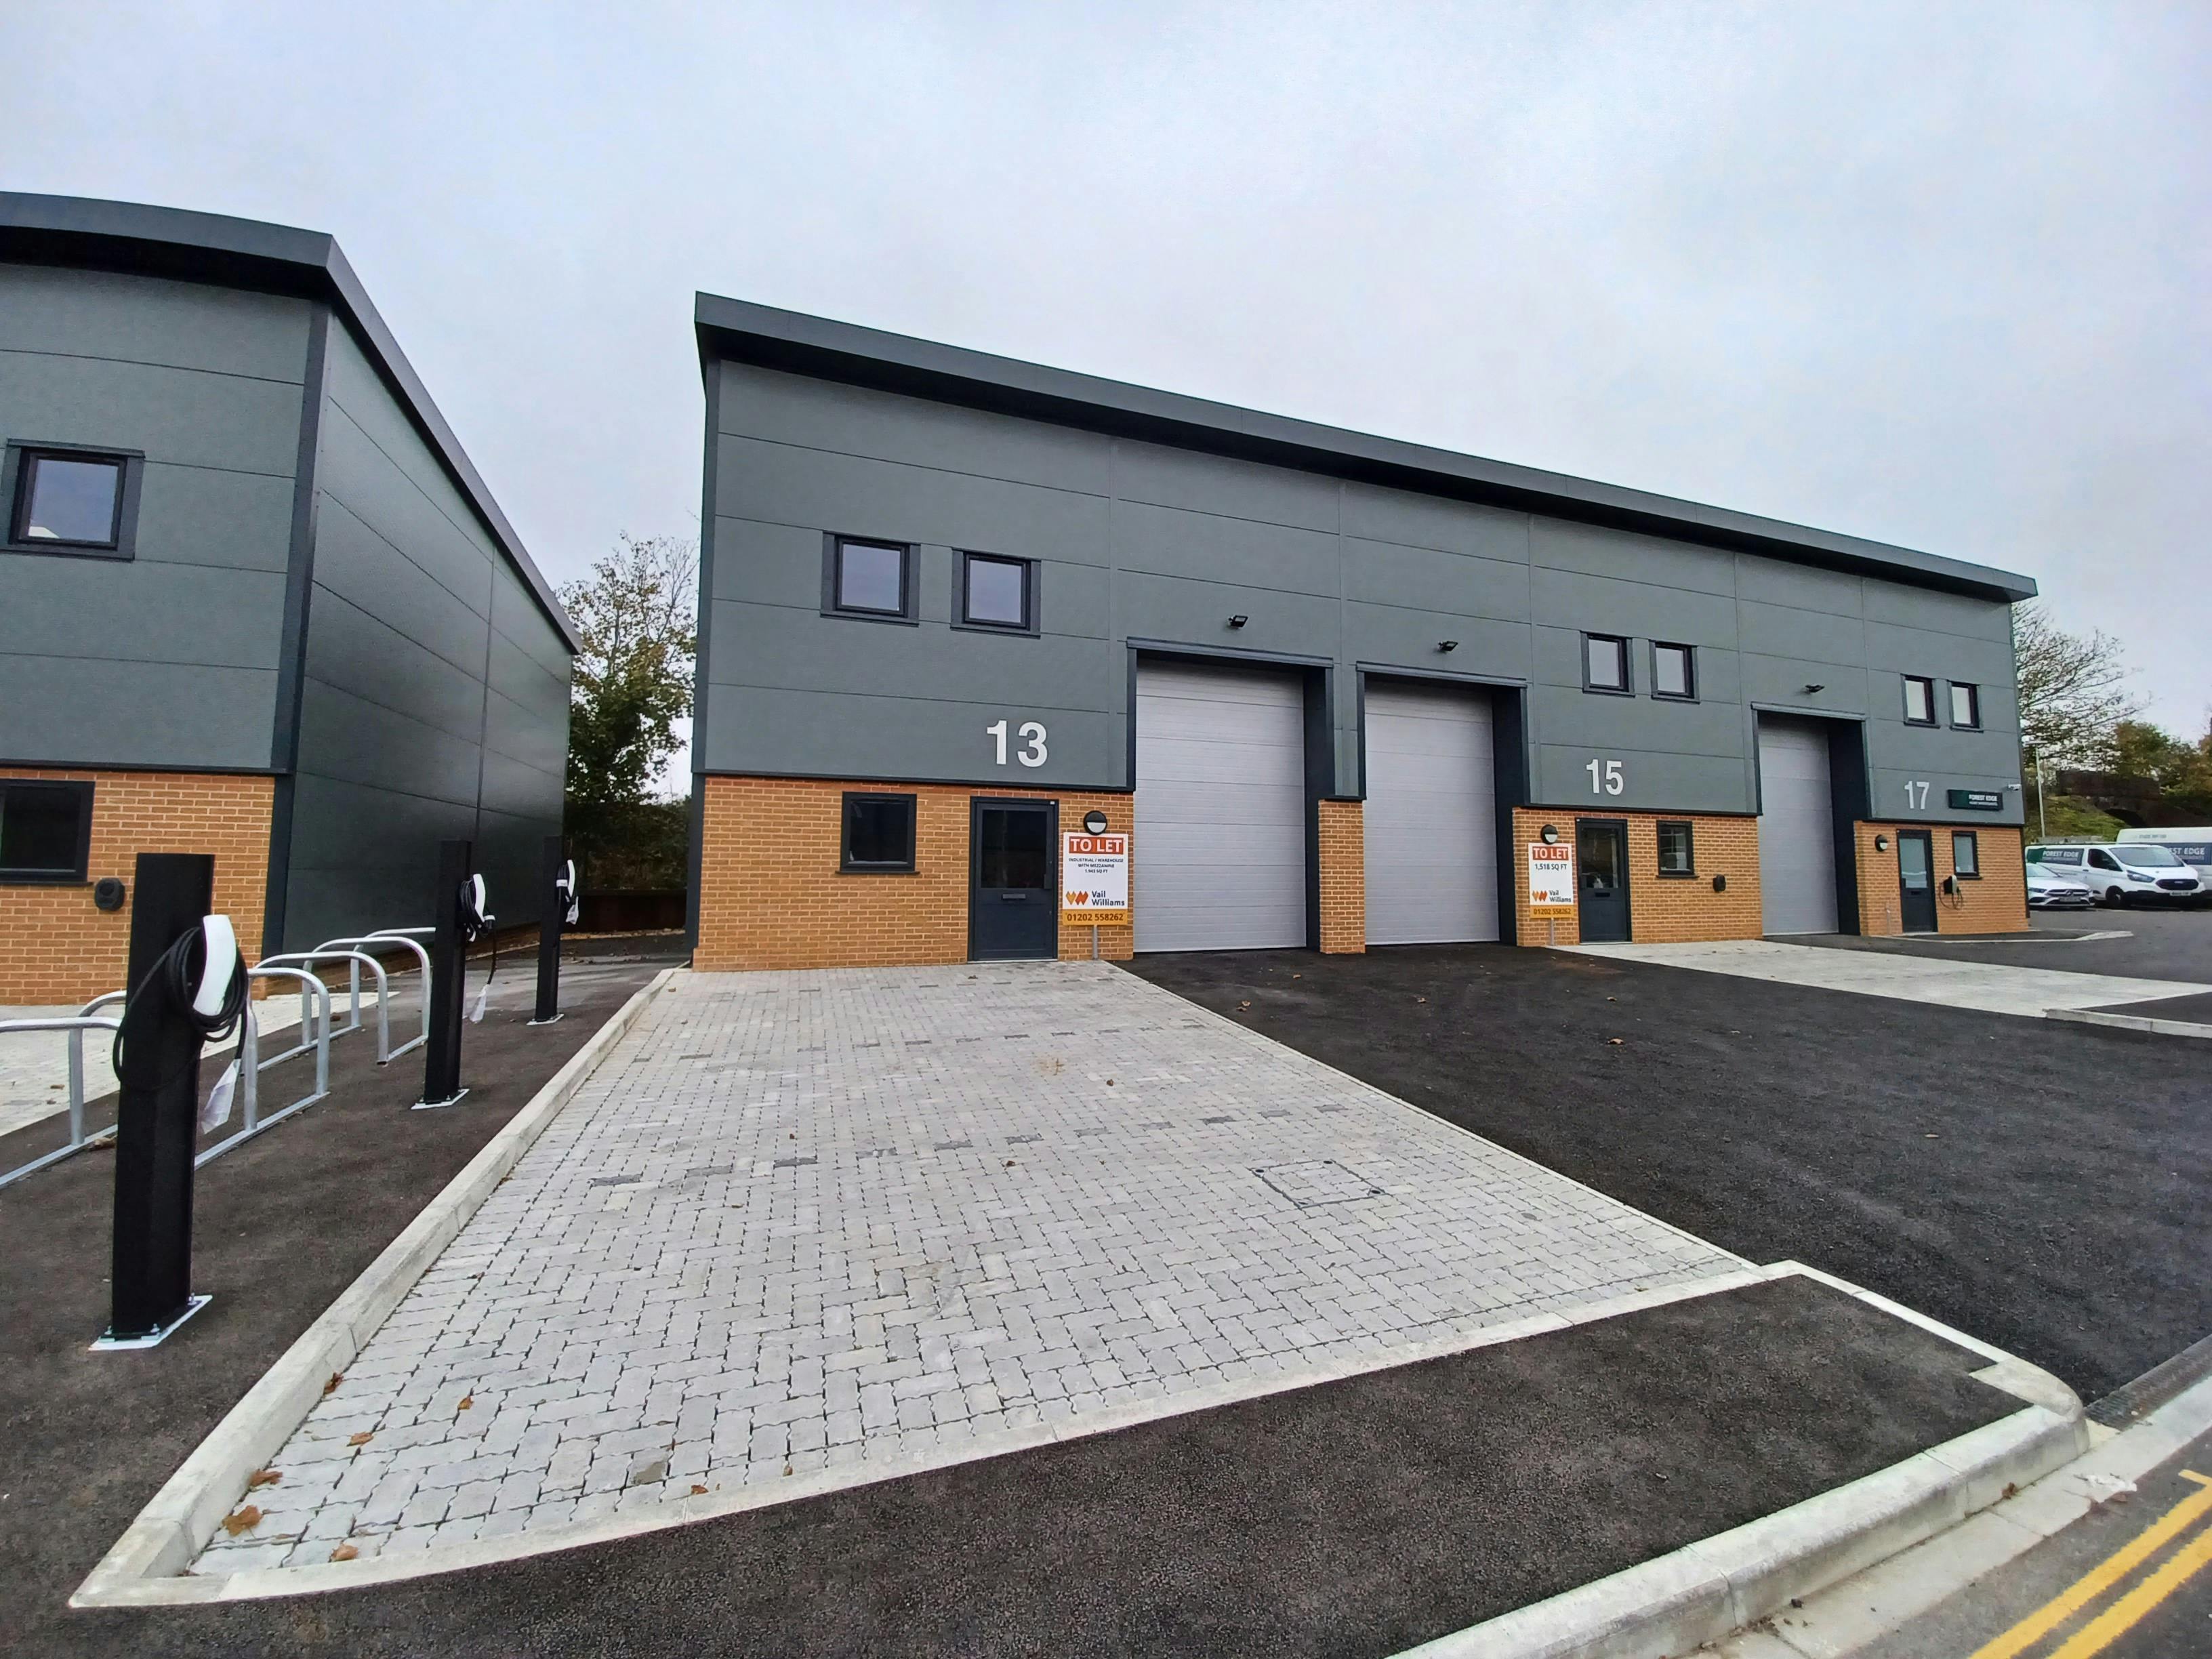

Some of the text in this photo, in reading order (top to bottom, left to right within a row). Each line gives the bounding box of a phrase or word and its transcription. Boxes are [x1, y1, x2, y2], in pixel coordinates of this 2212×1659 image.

[987, 720, 1048, 767] 13
[1586, 758, 1624, 796] 15
[1904, 781, 1929, 810] 17
[1070, 838, 1123, 853] TO LET
[1533, 848, 1568, 859] TO LET
[1067, 913, 1124, 921] 01202 558262
